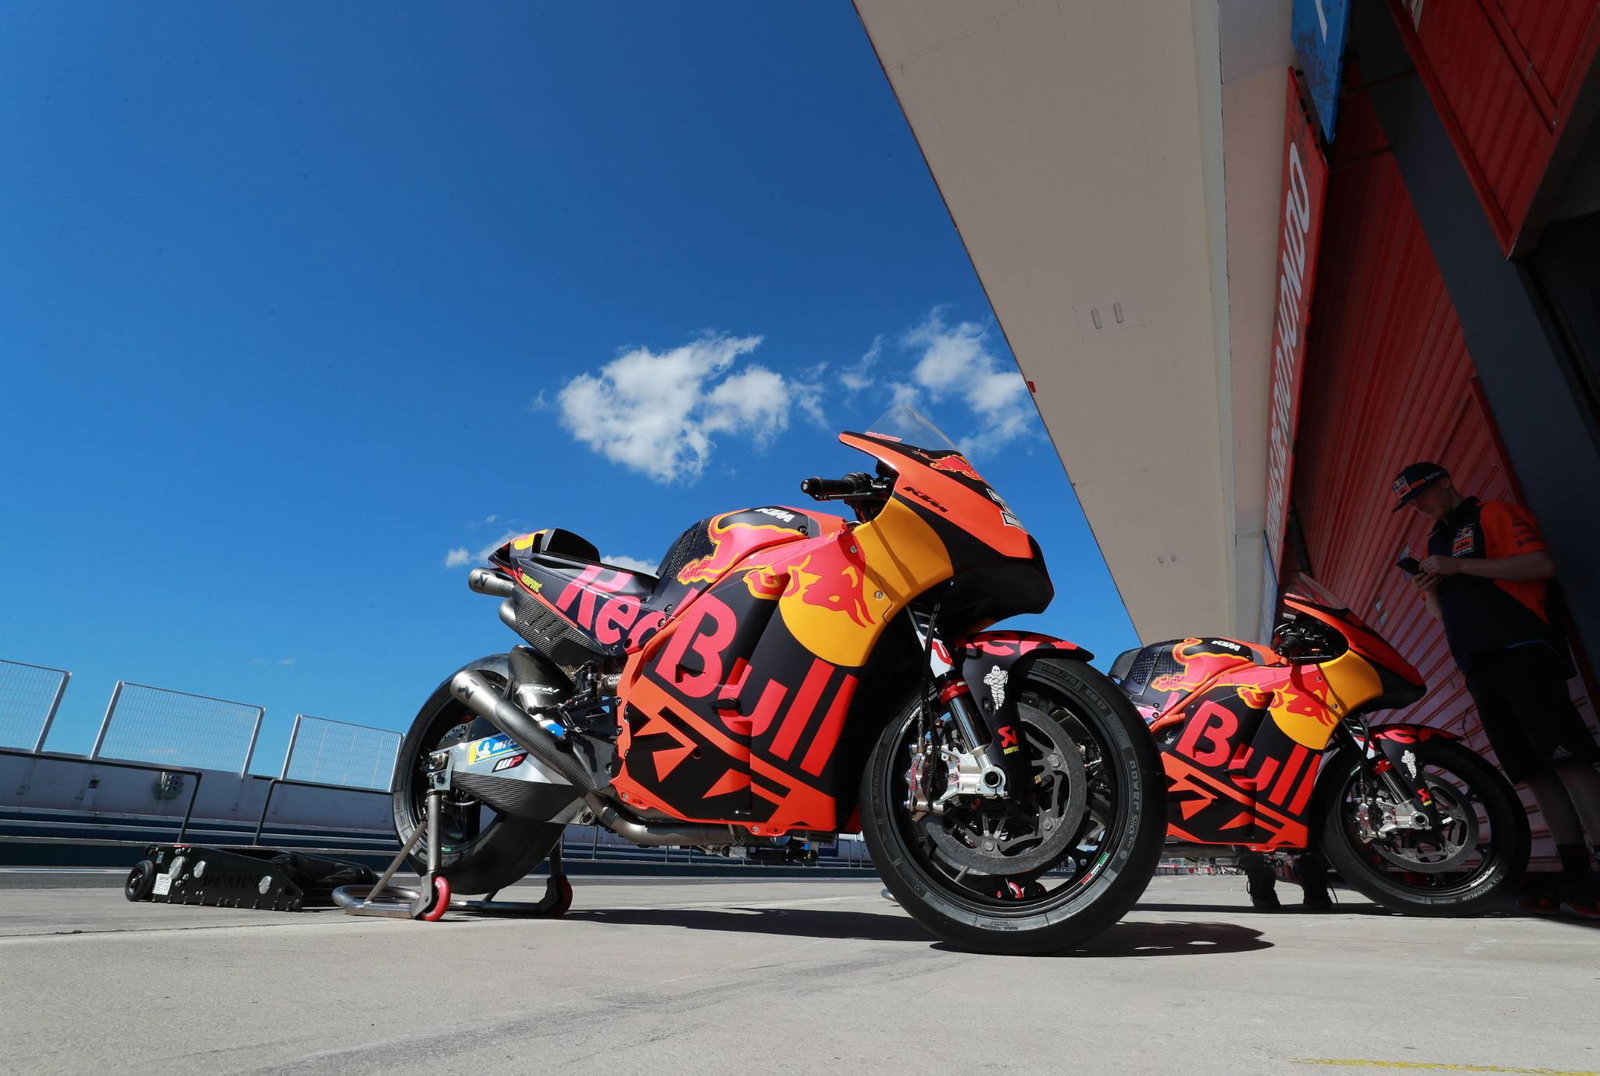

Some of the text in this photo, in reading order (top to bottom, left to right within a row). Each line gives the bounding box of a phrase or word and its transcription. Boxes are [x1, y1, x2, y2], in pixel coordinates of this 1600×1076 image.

[1278, 141, 1311, 382] HONDO
[757, 507, 795, 523] KTM
[903, 487, 948, 512] KTM
[655, 592, 860, 778] Bull
[1175, 700, 1322, 818] Bull
